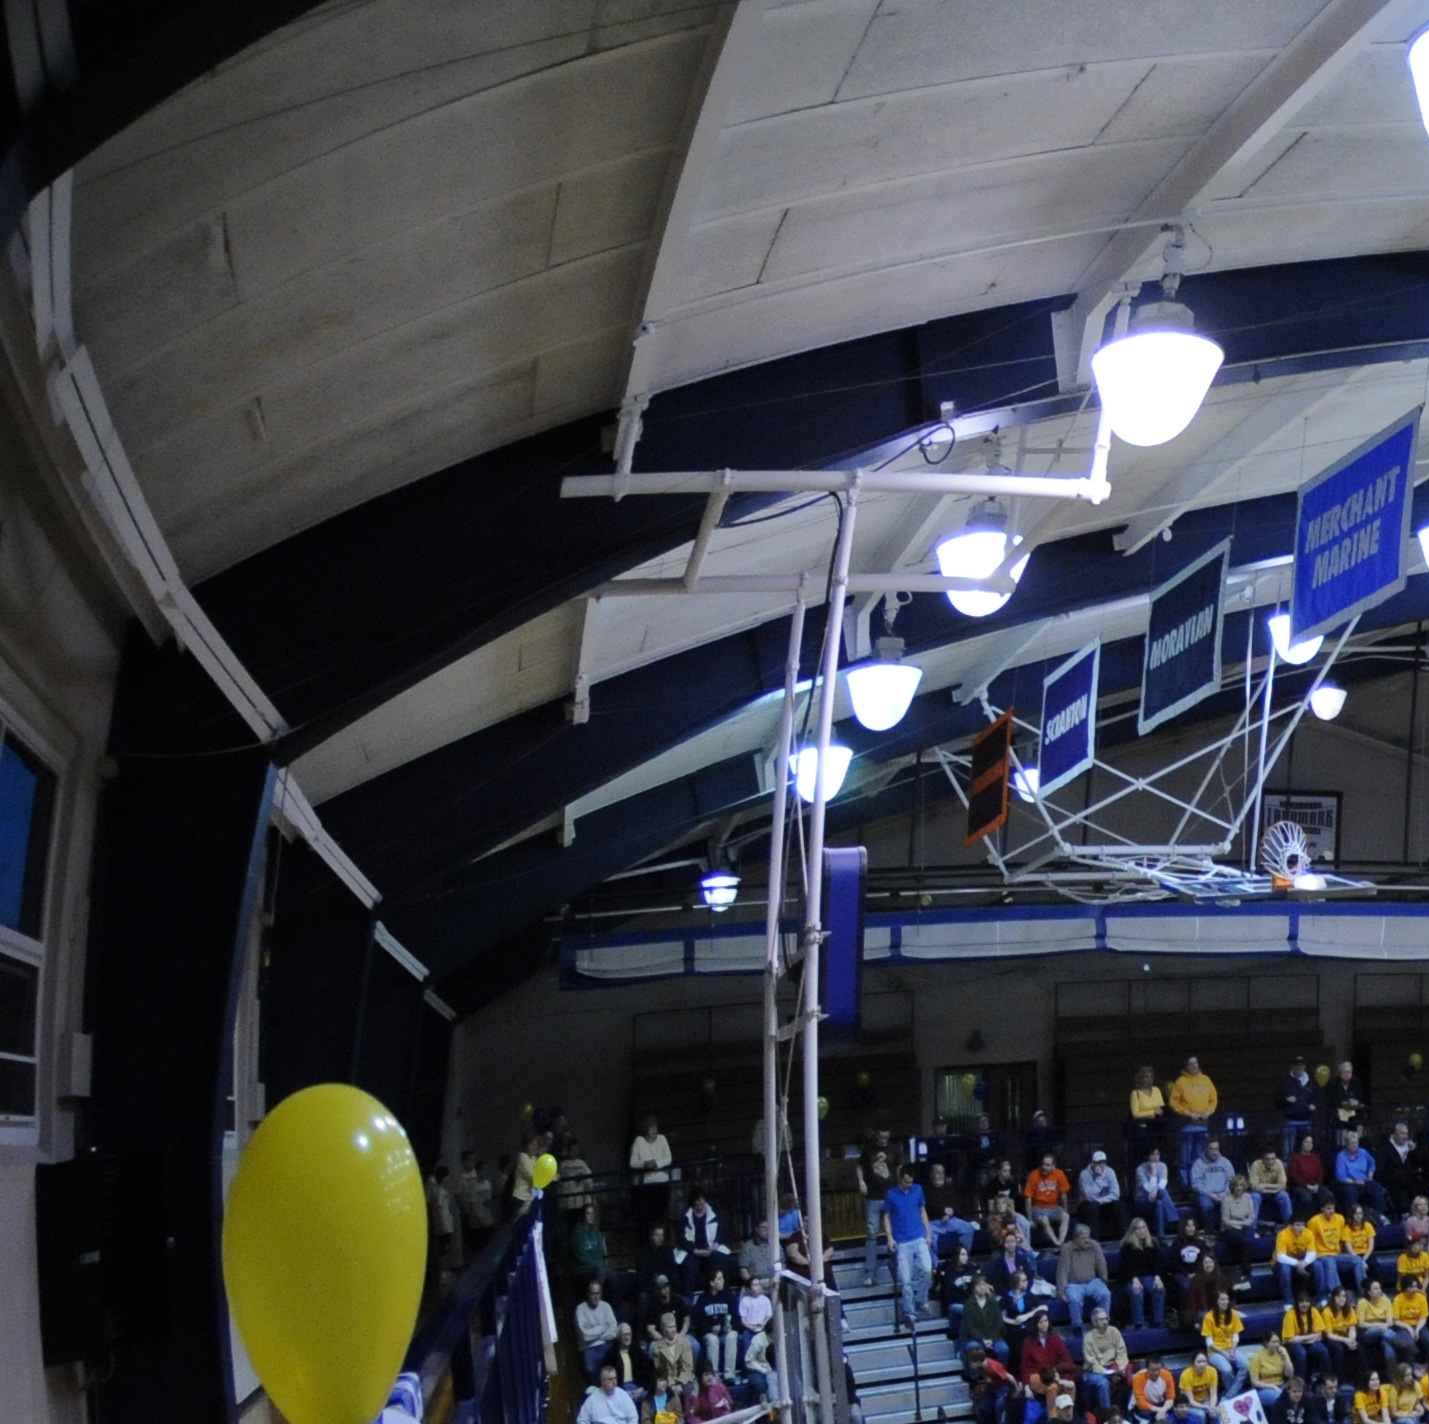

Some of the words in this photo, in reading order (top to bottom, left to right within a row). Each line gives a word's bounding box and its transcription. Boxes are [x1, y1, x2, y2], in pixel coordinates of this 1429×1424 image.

[1304, 465, 1401, 555] MERCHANT
[1312, 518, 1380, 589] MARINE
[1150, 603, 1214, 670] MORAVIAN
